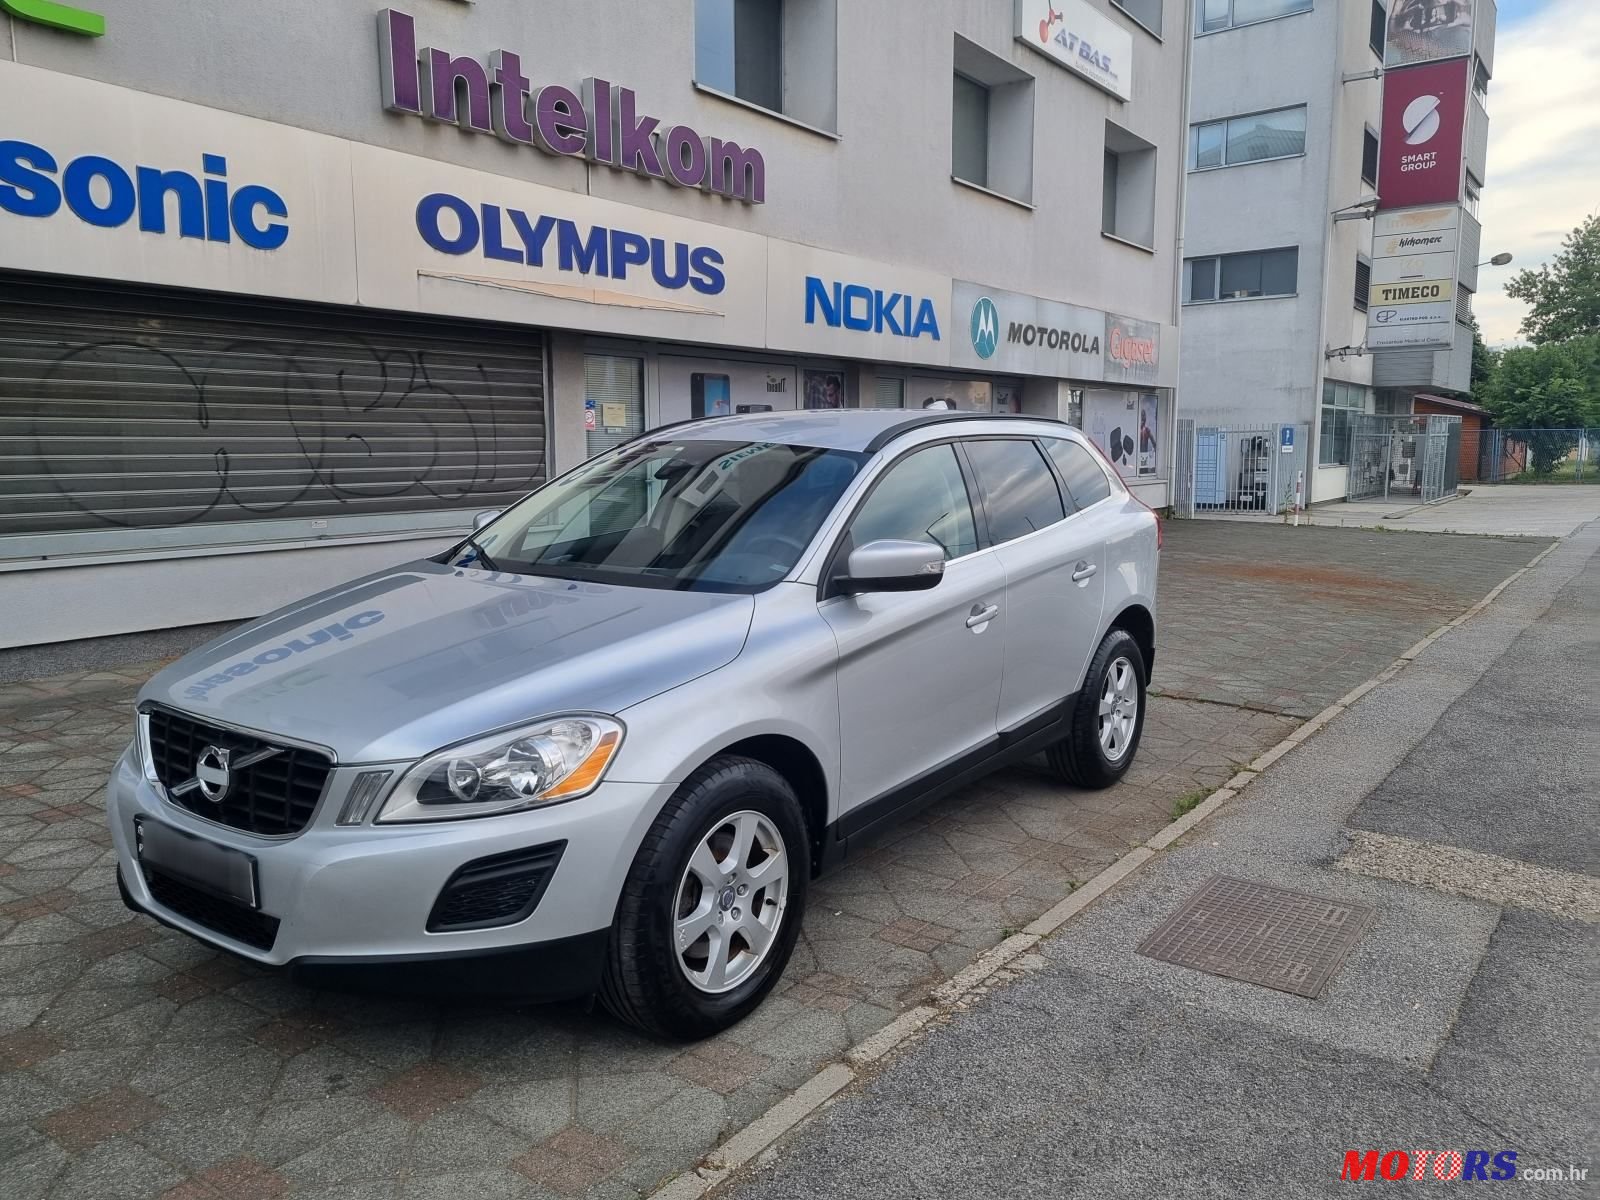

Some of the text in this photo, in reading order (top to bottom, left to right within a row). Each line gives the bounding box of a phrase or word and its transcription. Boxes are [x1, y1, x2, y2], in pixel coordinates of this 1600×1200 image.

[379, 8, 766, 204] Intelkom
[1400, 161, 1437, 172] GROUP
[1401, 152, 1437, 164] SMART
[0, 140, 288, 250] sonic
[416, 192, 725, 295] OLYMPUS
[805, 276, 940, 341] NOKIA
[1382, 285, 1440, 301] TIMECO
[1007, 321, 1100, 355] MOTOROLA
[1111, 328, 1153, 369] Gigaset
